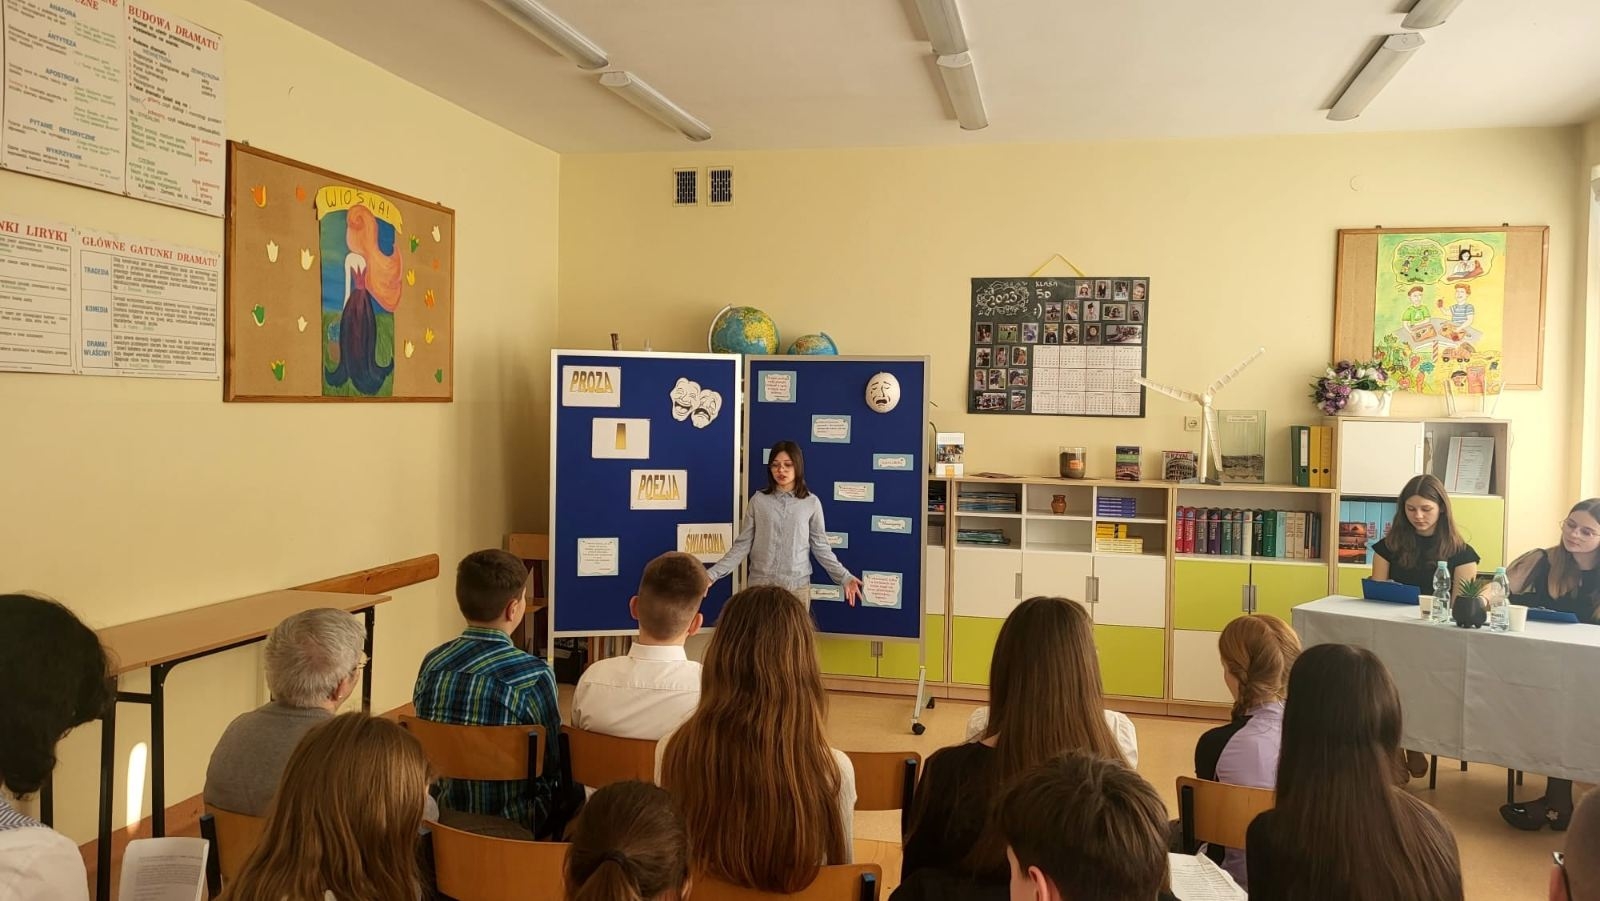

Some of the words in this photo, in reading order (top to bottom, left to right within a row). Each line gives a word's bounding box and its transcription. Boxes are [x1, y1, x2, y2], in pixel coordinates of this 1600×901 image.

[49, 3, 76, 18] ANAFORA
[128, 5, 170, 31] BUDOWA
[175, 25, 219, 51] DRAMATU
[47, 32, 76, 47] ANTYTEZA
[45, 68, 79, 83] APOSTROFA
[58, 126, 96, 141] RETORYCZNE
[325, 188, 390, 218] WIOSNA!
[26, 225, 68, 242] LIRYKI
[82, 236, 126, 252] GŁÓWNE
[130, 244, 173, 260] GATUNKI
[177, 252, 218, 268] DRAMATU
[987, 291, 1018, 307] 2023
[85, 305, 108, 314] KOMEDIA
[86, 340, 108, 348] DRAMAT
[570, 370, 614, 394] PROZA
[638, 474, 680, 501] POEZJA
[685, 529, 726, 555] ŚWIATOWA
